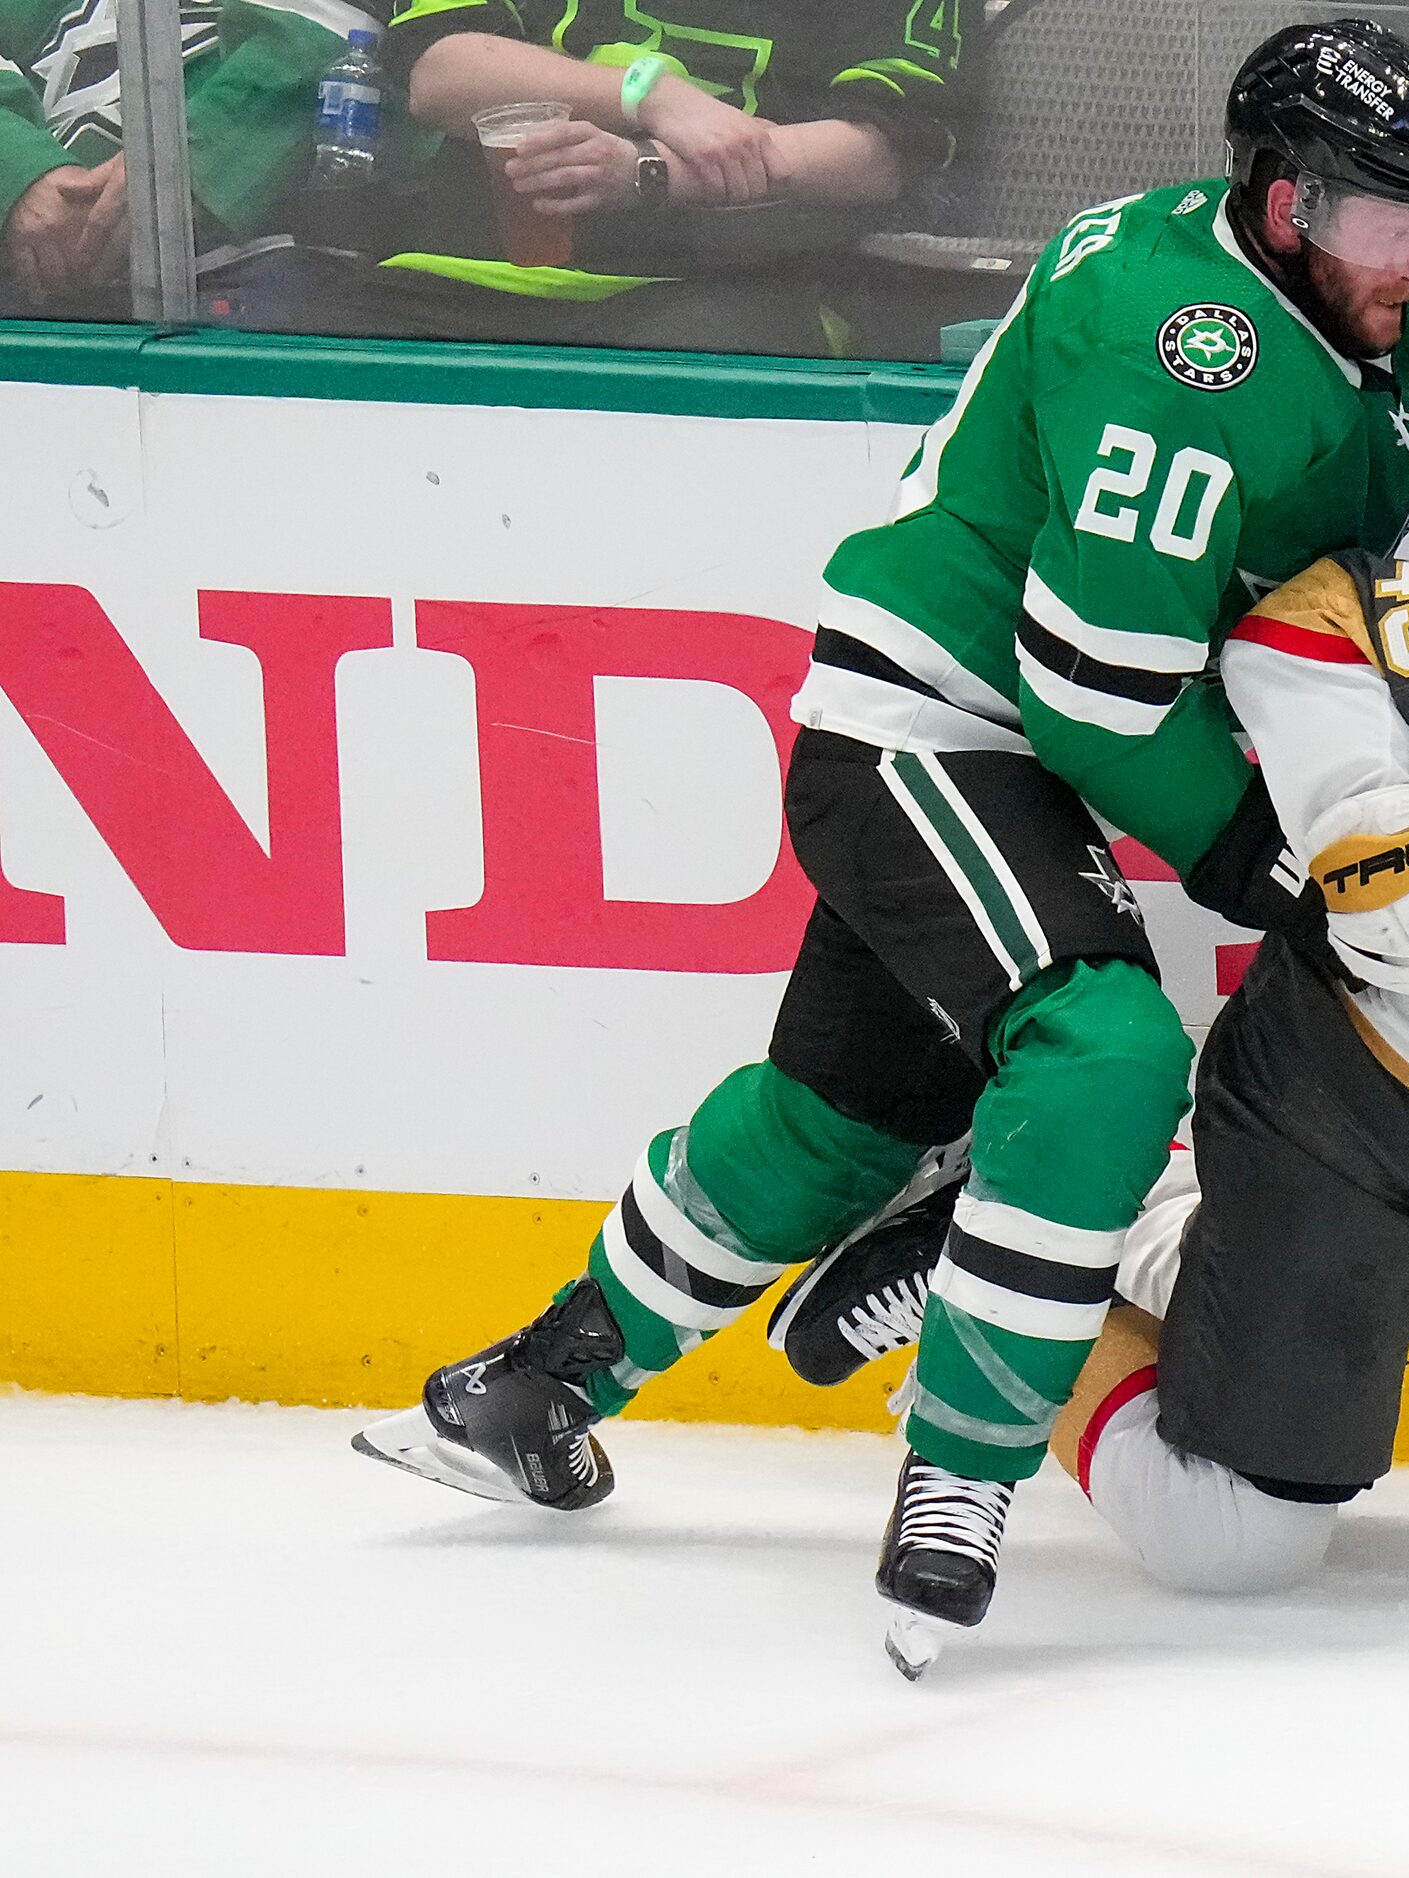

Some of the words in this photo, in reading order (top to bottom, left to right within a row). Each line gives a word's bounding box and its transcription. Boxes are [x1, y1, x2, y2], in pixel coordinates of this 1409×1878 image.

[1334, 70, 1395, 121] TRANSFER
[1342, 60, 1393, 99] ENERGY
[1175, 309, 1252, 358] DALLAS
[1164, 340, 1233, 384] STARS
[1074, 423, 1235, 562] 20
[526, 1453, 550, 1492] BAUER
